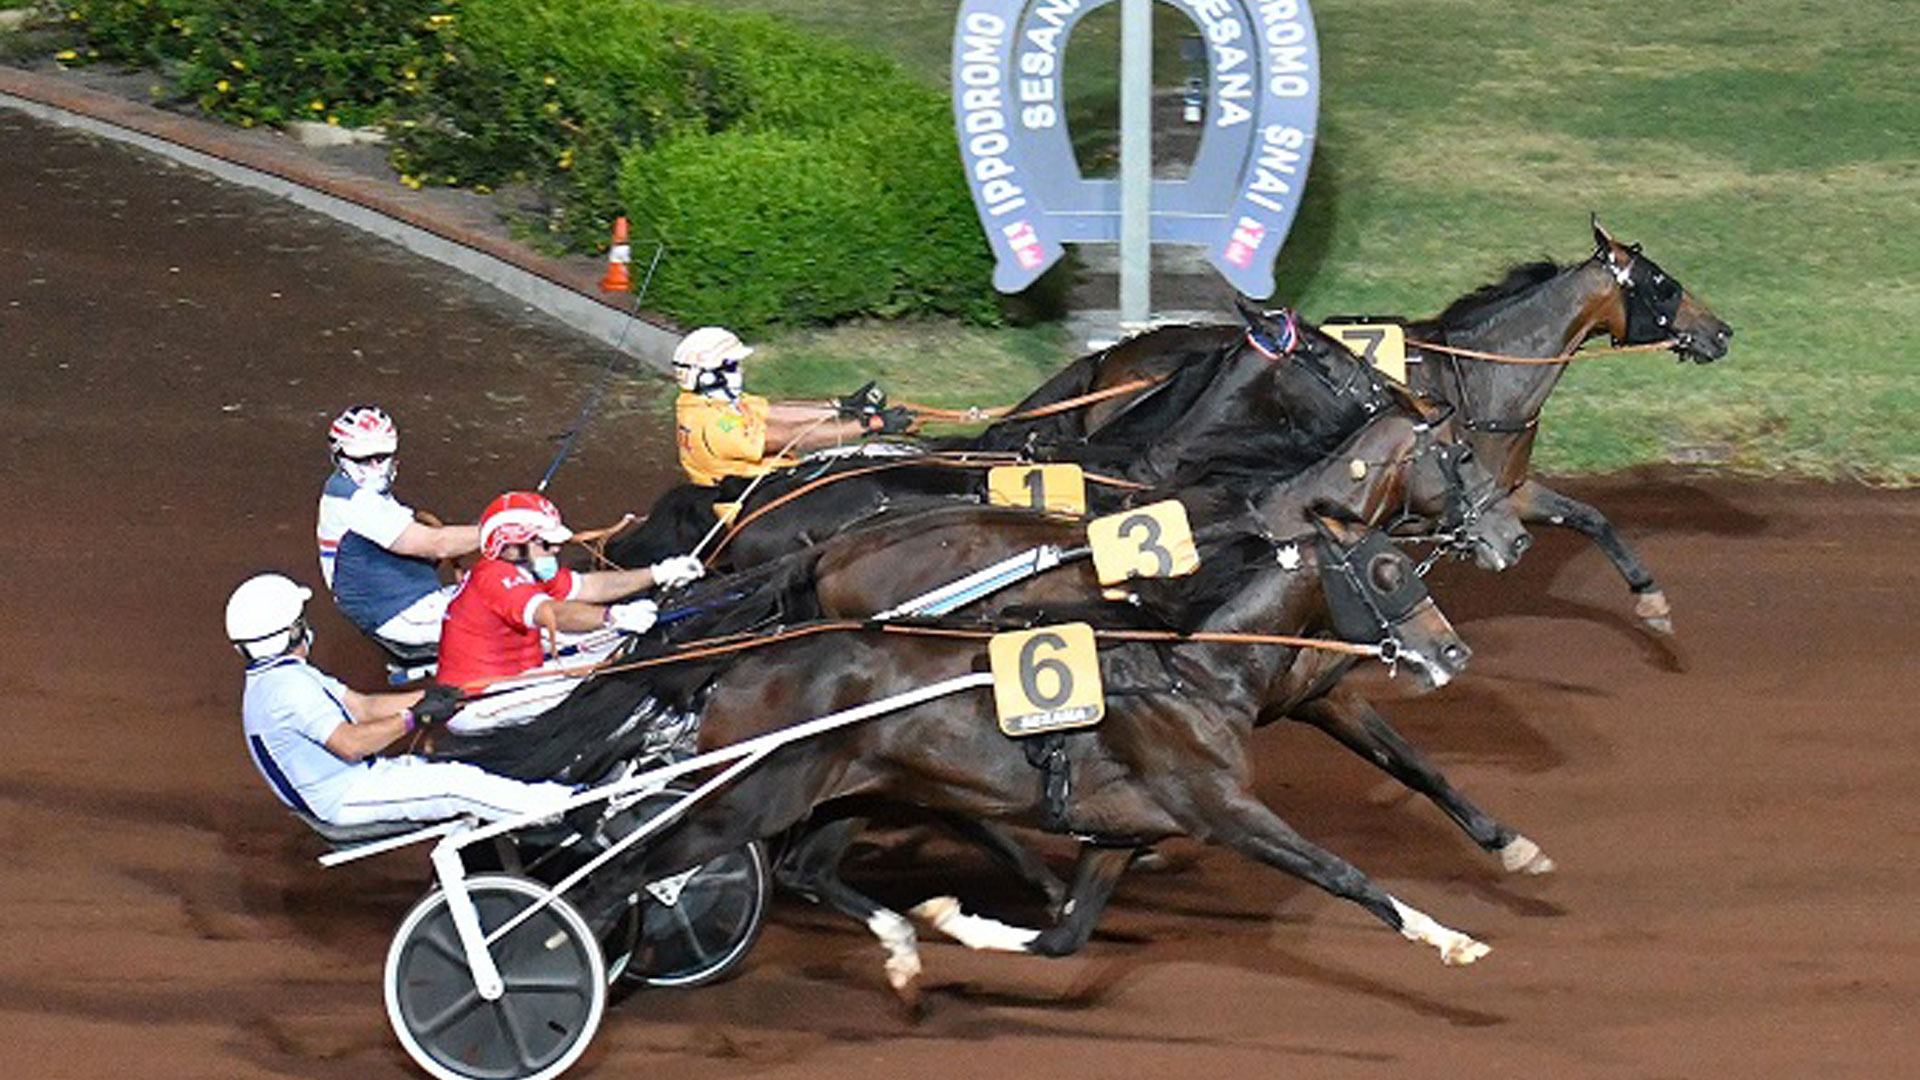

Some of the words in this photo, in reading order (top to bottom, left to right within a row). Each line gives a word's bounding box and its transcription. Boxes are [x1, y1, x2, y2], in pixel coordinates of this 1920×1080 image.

[1019, 0, 1080, 130] SESAN
[1183, 0, 1252, 128] ESANA
[1258, 0, 1310, 98] ROMO
[961, 12, 1026, 216] IPPODROMO
[1245, 124, 1304, 213] SNAI
[1341, 328, 1385, 366] 7
[1022, 469, 1045, 512] 1
[1117, 513, 1174, 579] 3
[1019, 632, 1074, 710] 6
